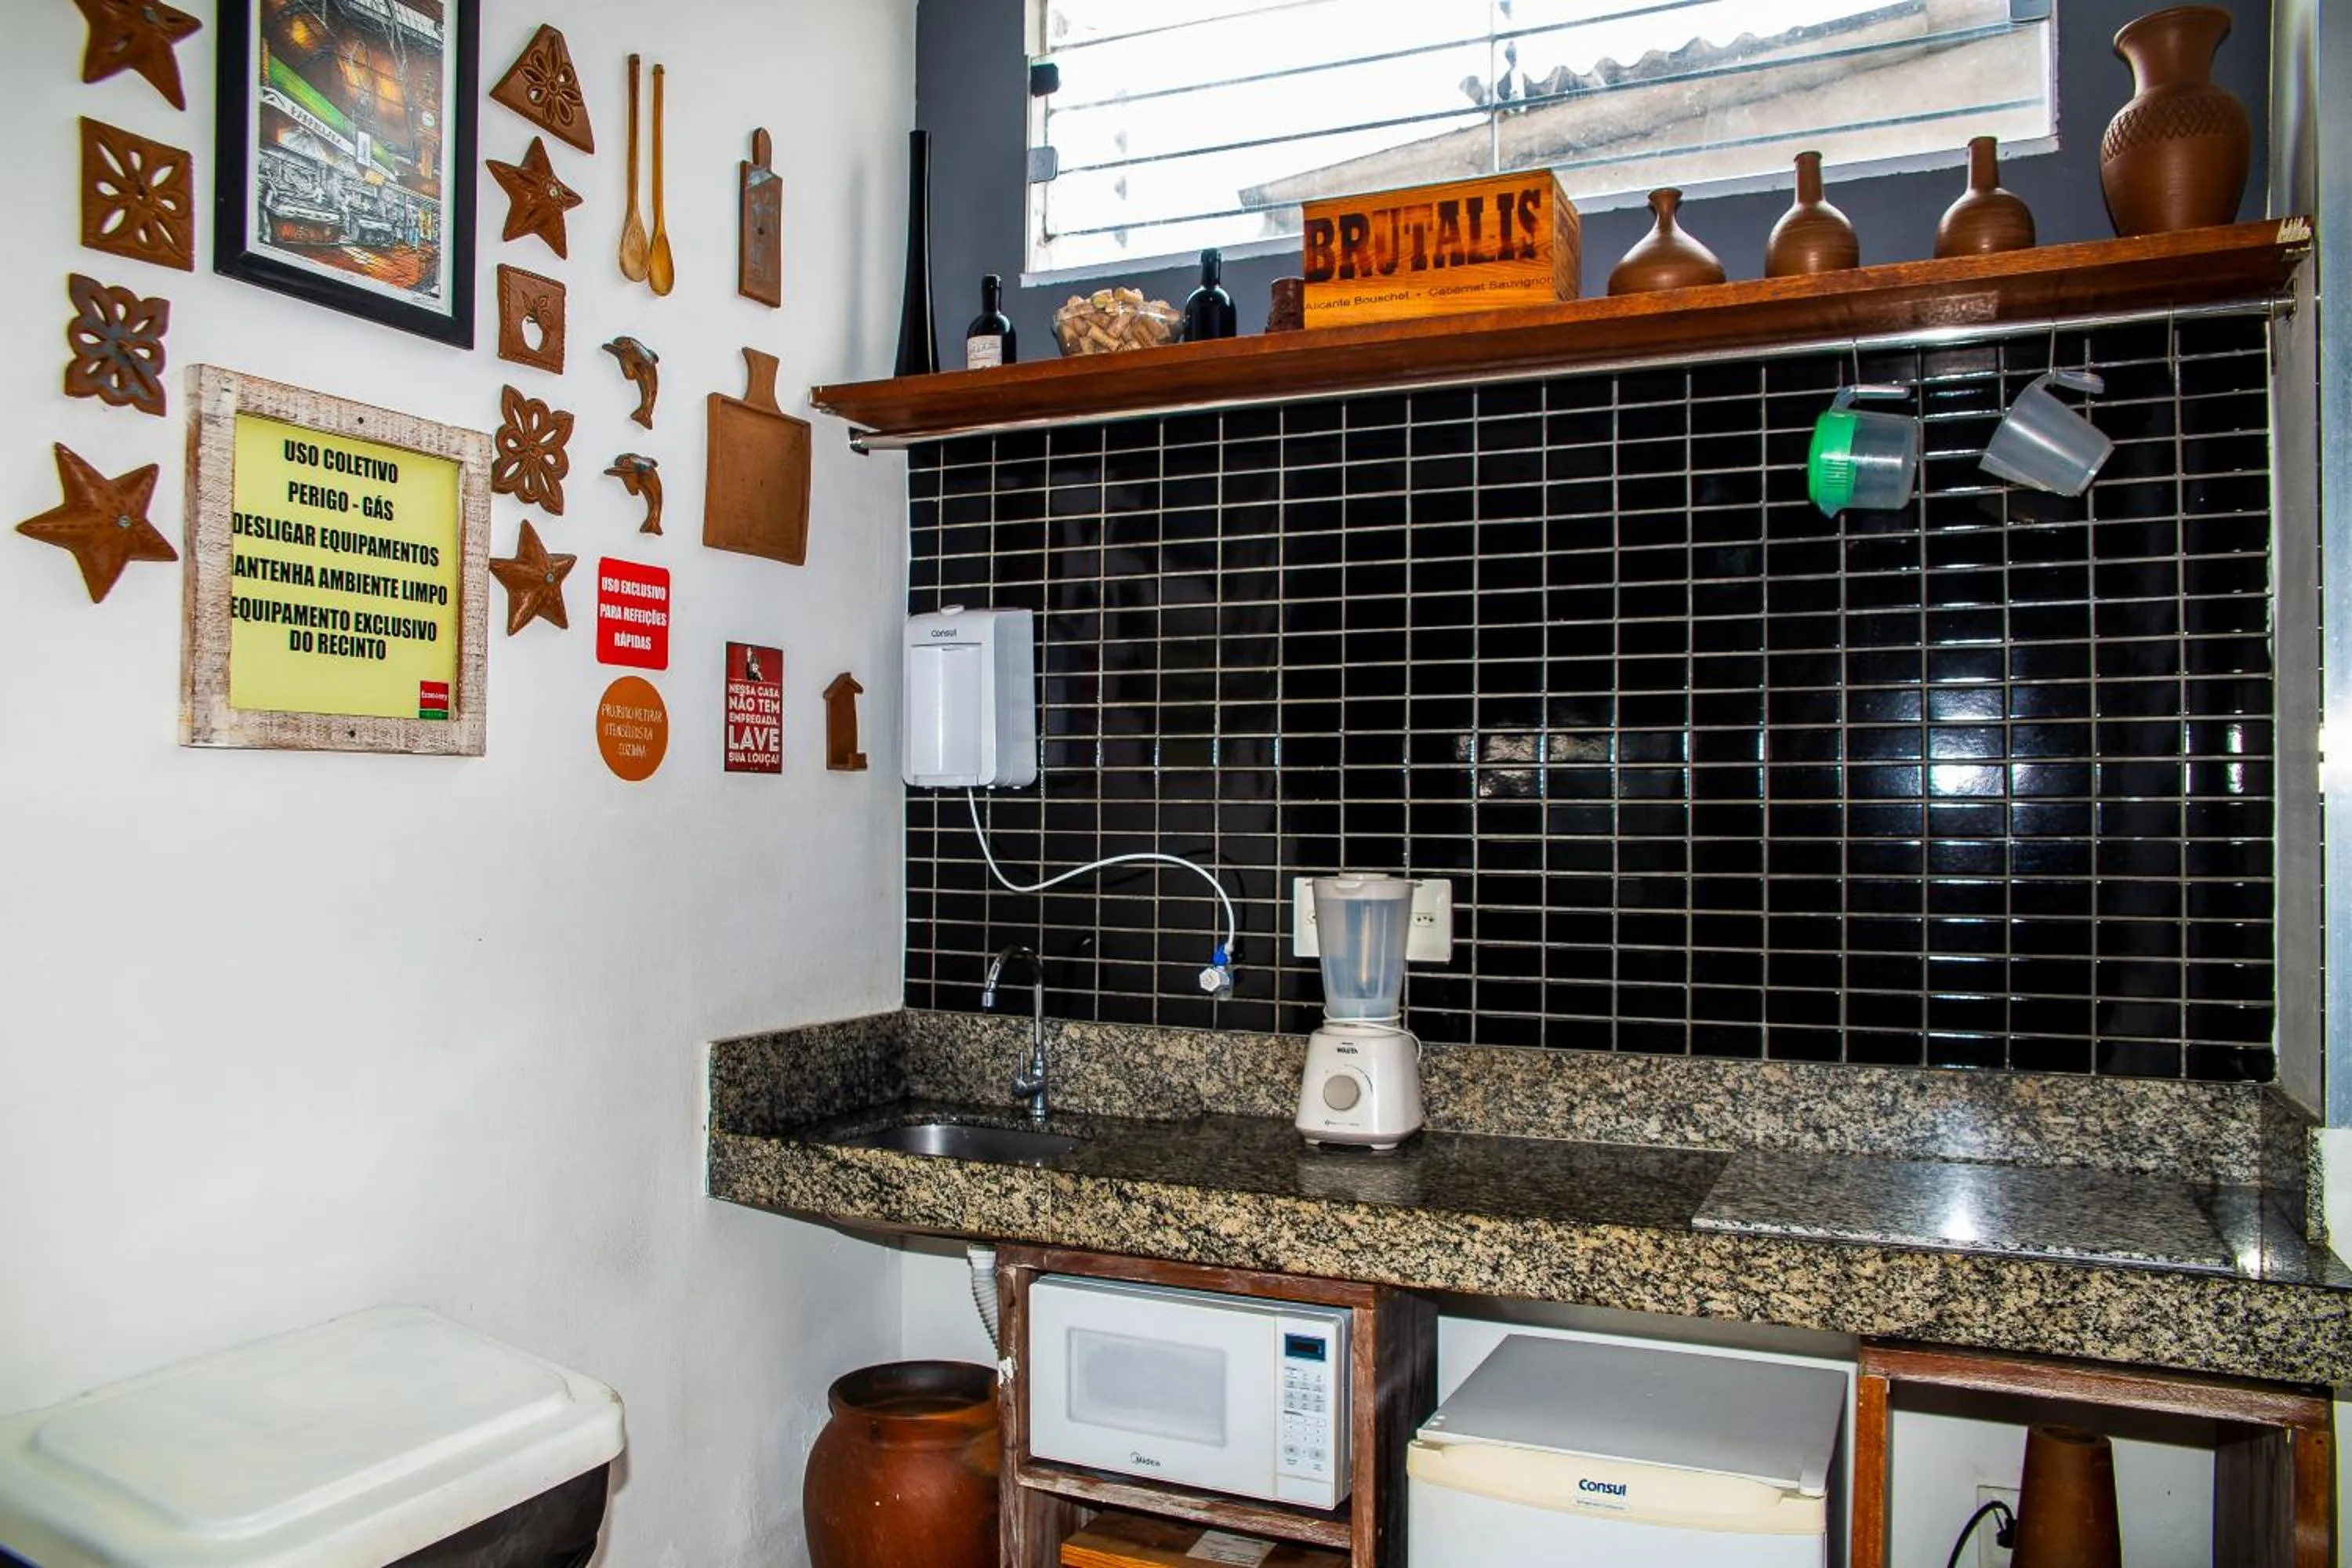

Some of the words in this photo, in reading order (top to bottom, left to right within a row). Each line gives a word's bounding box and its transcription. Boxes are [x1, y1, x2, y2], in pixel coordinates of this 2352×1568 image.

[1305, 189, 1541, 283] BRUTALIS
[1490, 276, 1555, 289] Sauvignon
[285, 439, 319, 466] USO
[323, 448, 398, 484] COLETIVO
[288, 481, 349, 512] PERIGO
[362, 495, 394, 521] GÁS
[233, 512, 315, 546] DESLIGAR
[319, 527, 440, 567] EQUIPAMENTOS
[232, 554, 315, 587] ANTENHA
[318, 567, 399, 599] AMBIENTE
[401, 579, 448, 605] LIMPO
[601, 576, 620, 593] USO
[621, 580, 666, 601] EXCLUSIVO
[231, 596, 350, 632] EQUIPAMENTO
[354, 611, 437, 642] EXCLUSIVO
[600, 603, 622, 620] PARA
[623, 607, 667, 627] REFEIÇÕES
[289, 630, 313, 653] DO
[318, 633, 387, 661] RECINTO
[614, 630, 652, 651] RÁPIDAS
[931, 629, 957, 637] Consul
[728, 695, 755, 712] NÃO
[757, 699, 780, 714] TEM
[757, 686, 779, 699] CASA
[729, 724, 779, 752] LAVE
[728, 753, 746, 764] SUA
[1579, 1479, 1627, 1496] Consul
